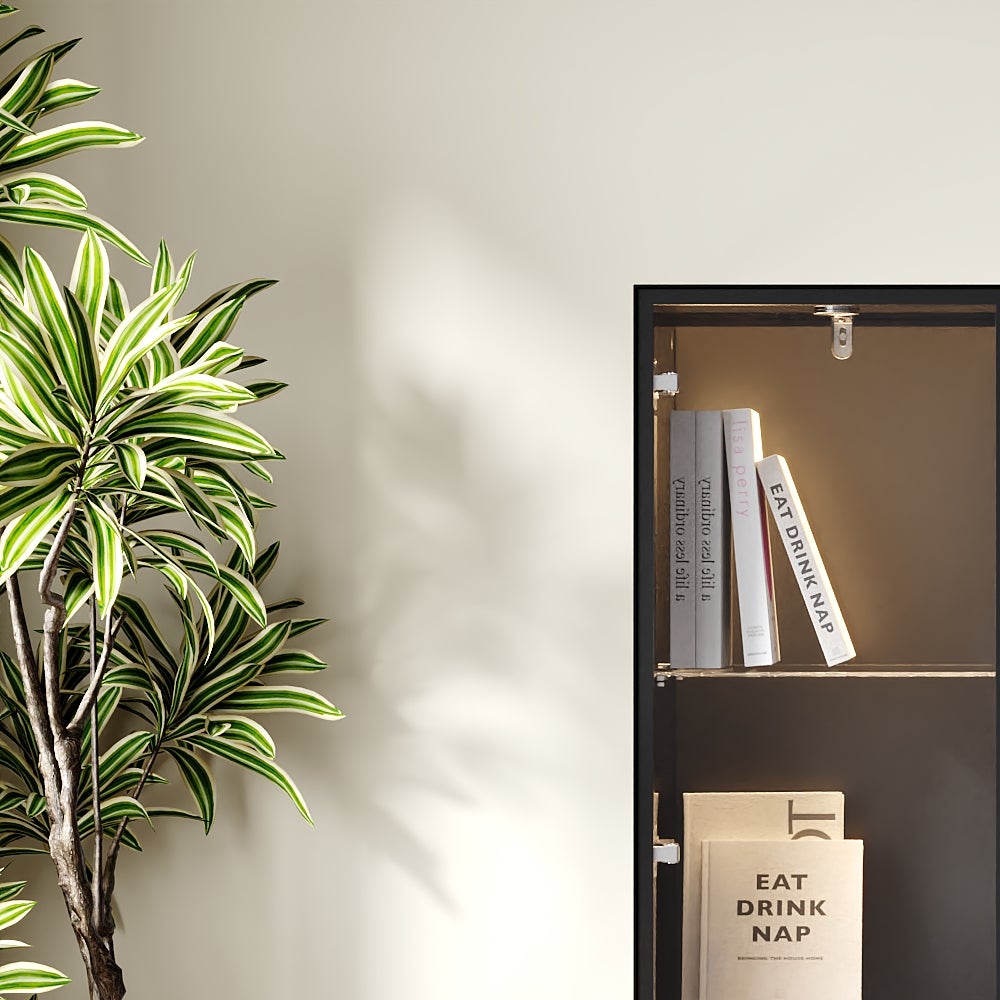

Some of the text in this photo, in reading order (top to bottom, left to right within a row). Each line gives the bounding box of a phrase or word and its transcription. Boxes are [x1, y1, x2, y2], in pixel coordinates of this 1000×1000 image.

[732, 419, 750, 518] lisa perry
[769, 483, 835, 634] EAT DRINK NAP
[788, 799, 836, 840] T
[756, 874, 808, 891] EAT
[736, 900, 827, 916] DRINK
[752, 926, 811, 942] NAP
